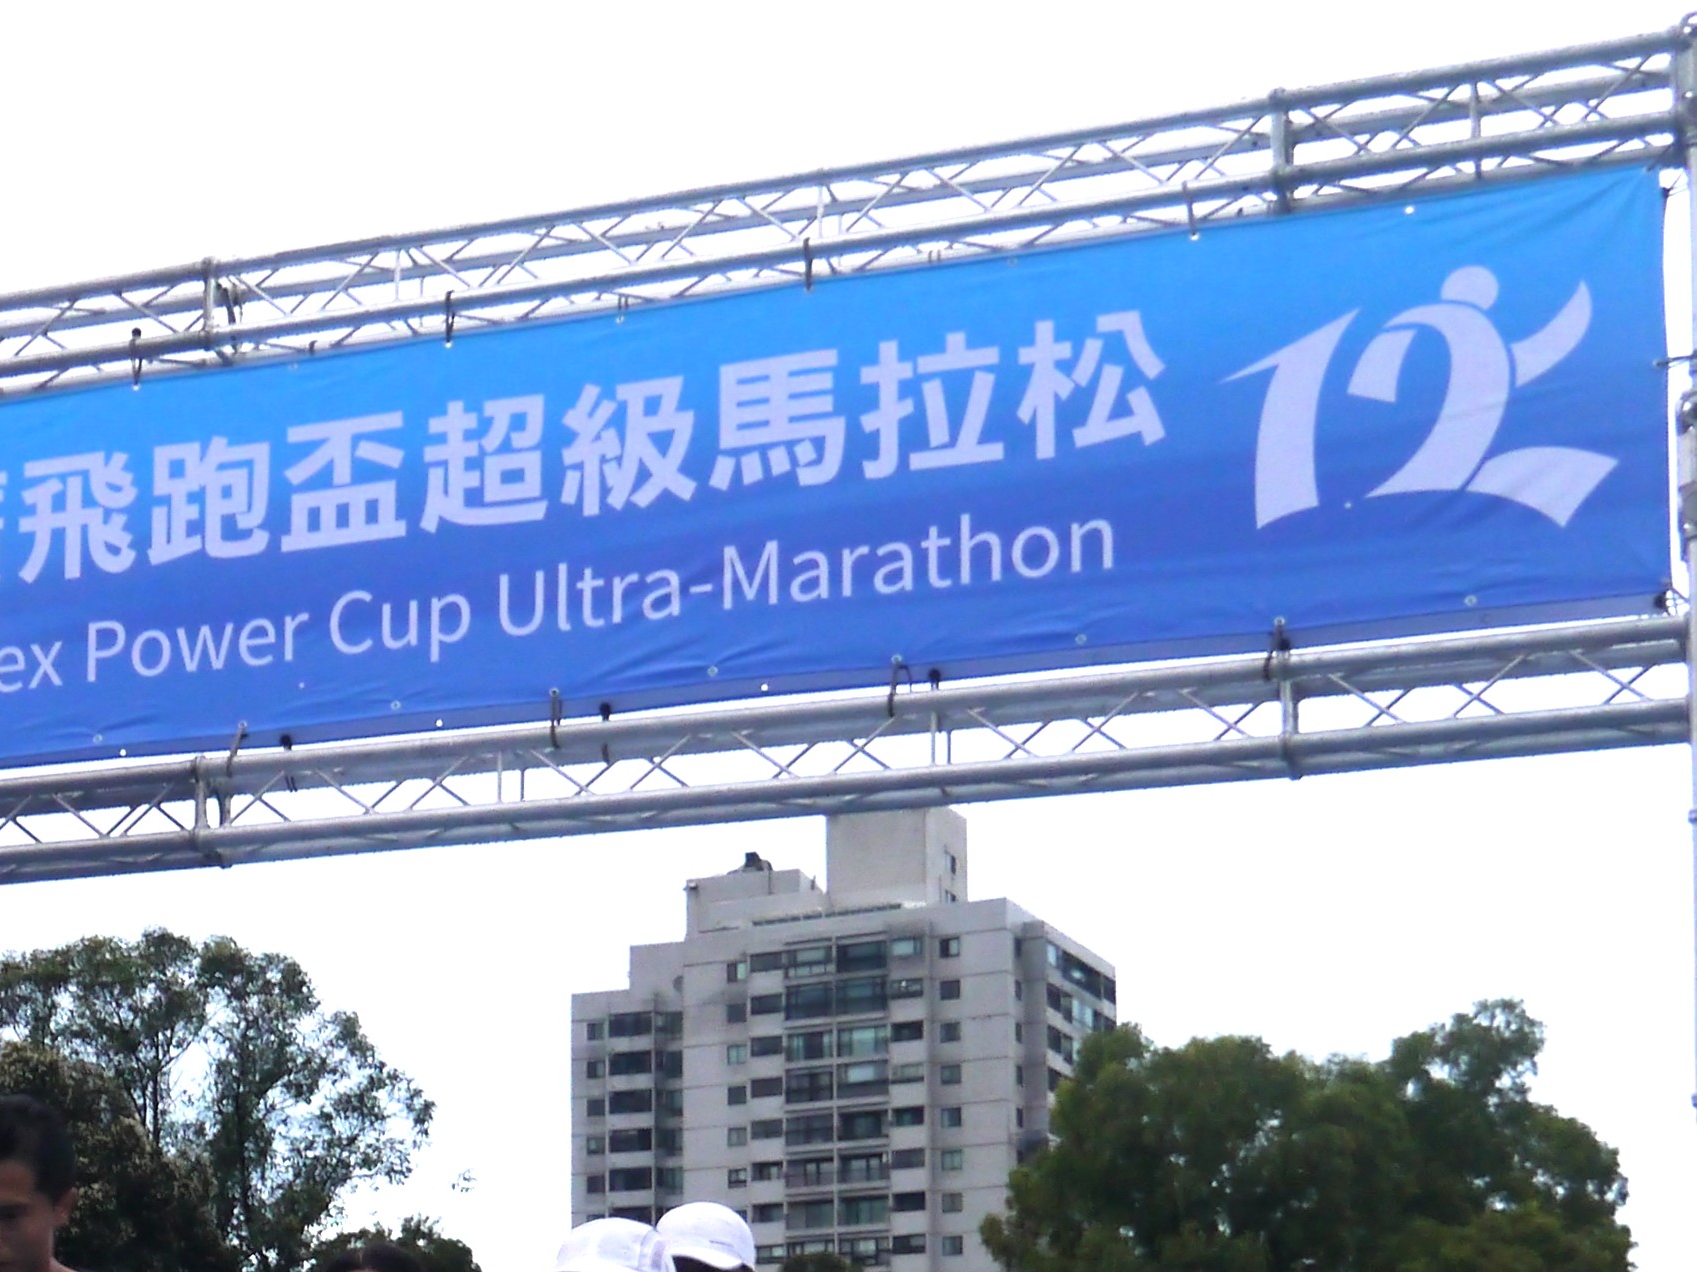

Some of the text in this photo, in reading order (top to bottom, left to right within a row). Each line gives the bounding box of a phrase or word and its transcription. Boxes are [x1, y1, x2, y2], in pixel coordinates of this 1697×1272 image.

[87, 606, 309, 682] Power
[330, 591, 472, 662] Cup
[498, 507, 1114, 640] Ultra-Marathon
